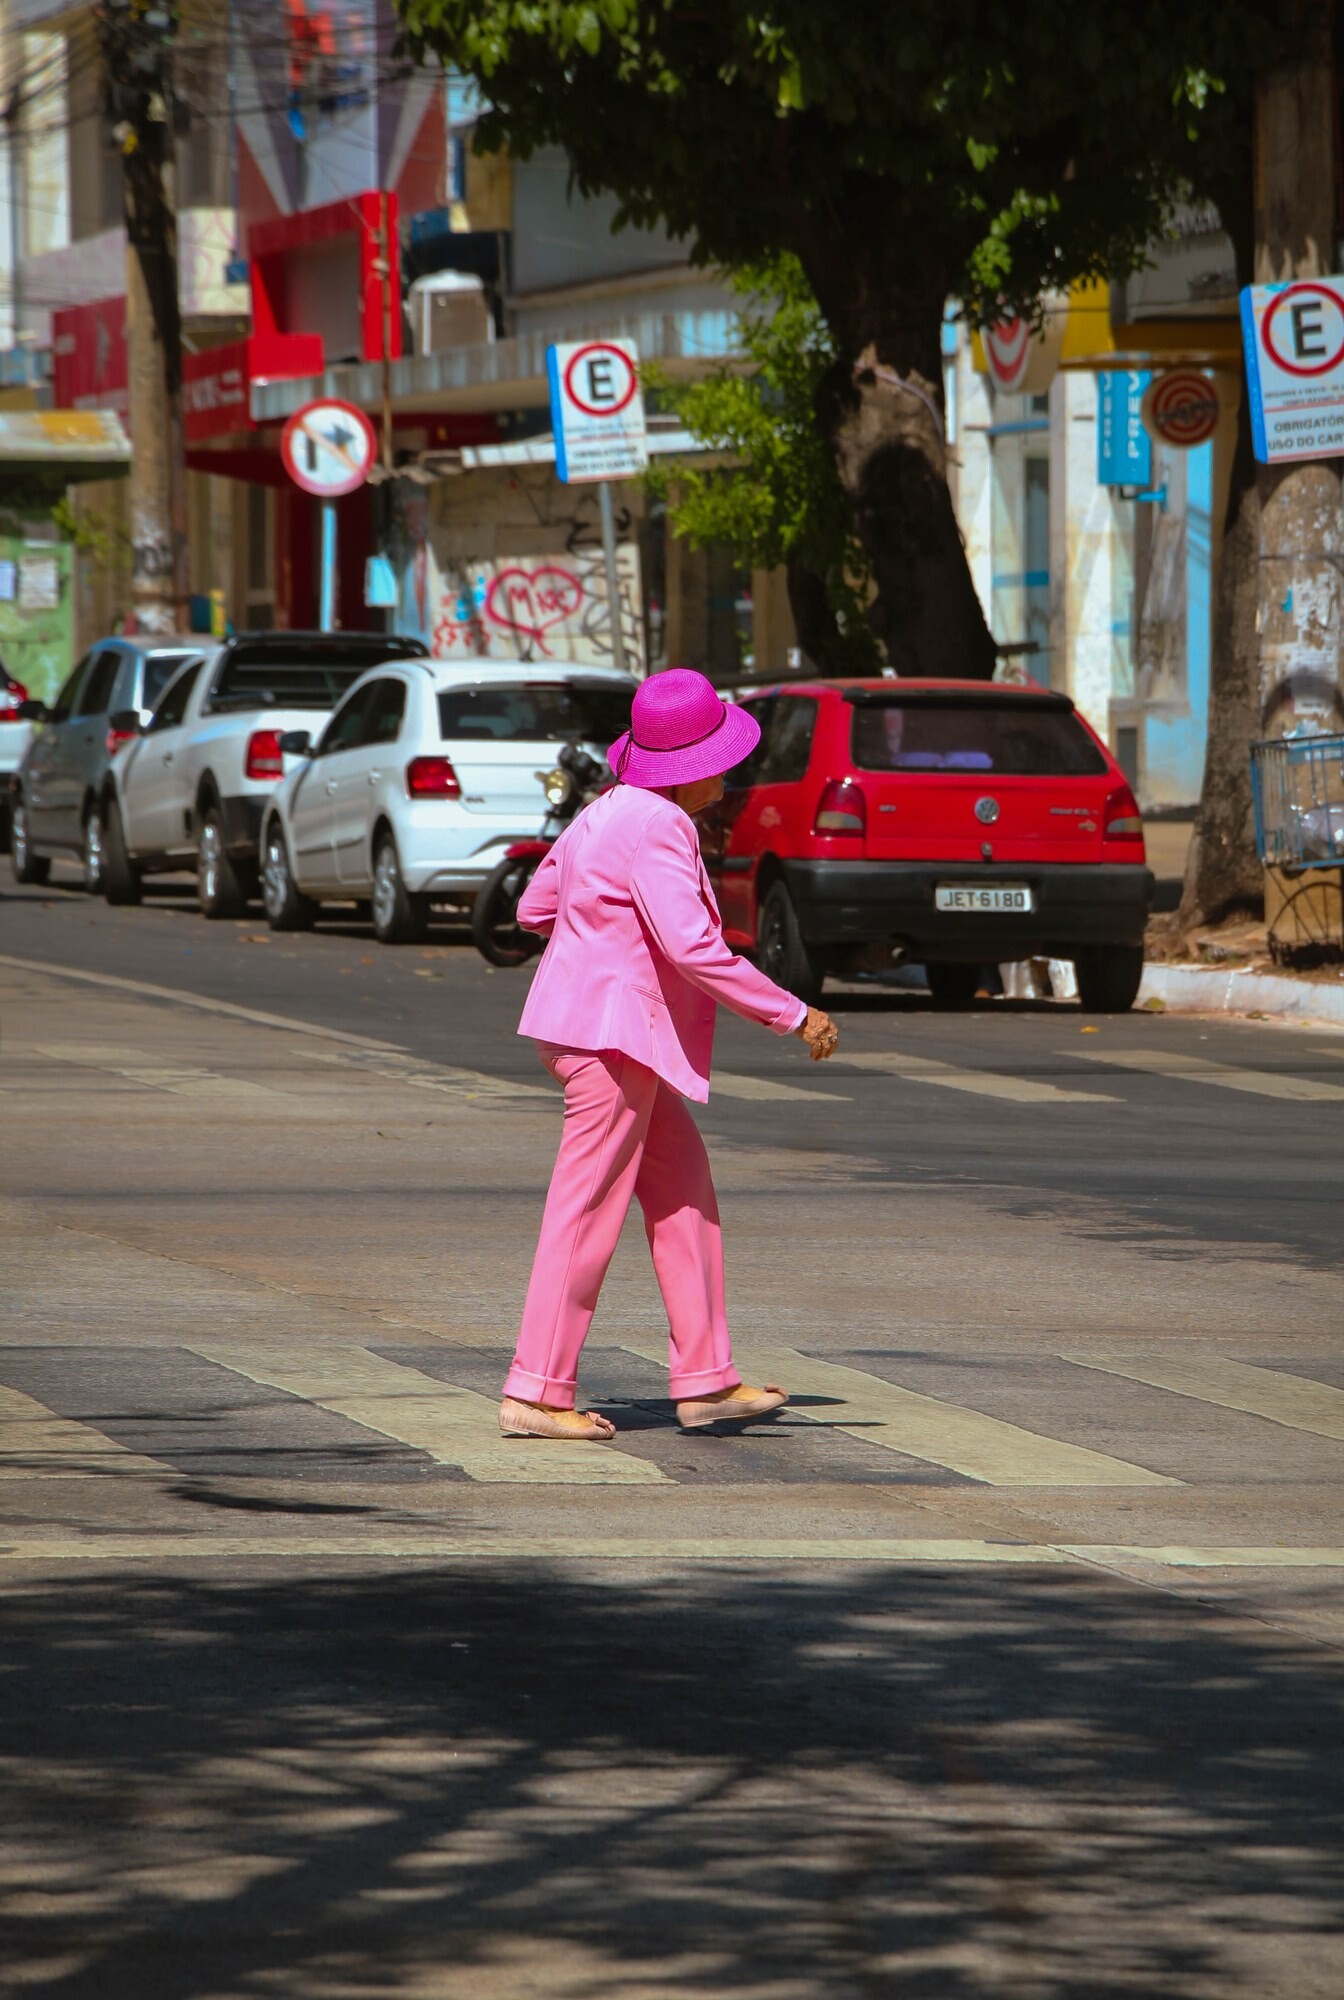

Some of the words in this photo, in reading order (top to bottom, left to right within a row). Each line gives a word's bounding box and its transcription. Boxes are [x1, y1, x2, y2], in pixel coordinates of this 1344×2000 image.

[1291, 301, 1326, 359] E
[586, 359, 614, 400] E
[1296, 435, 1314, 447] DO
